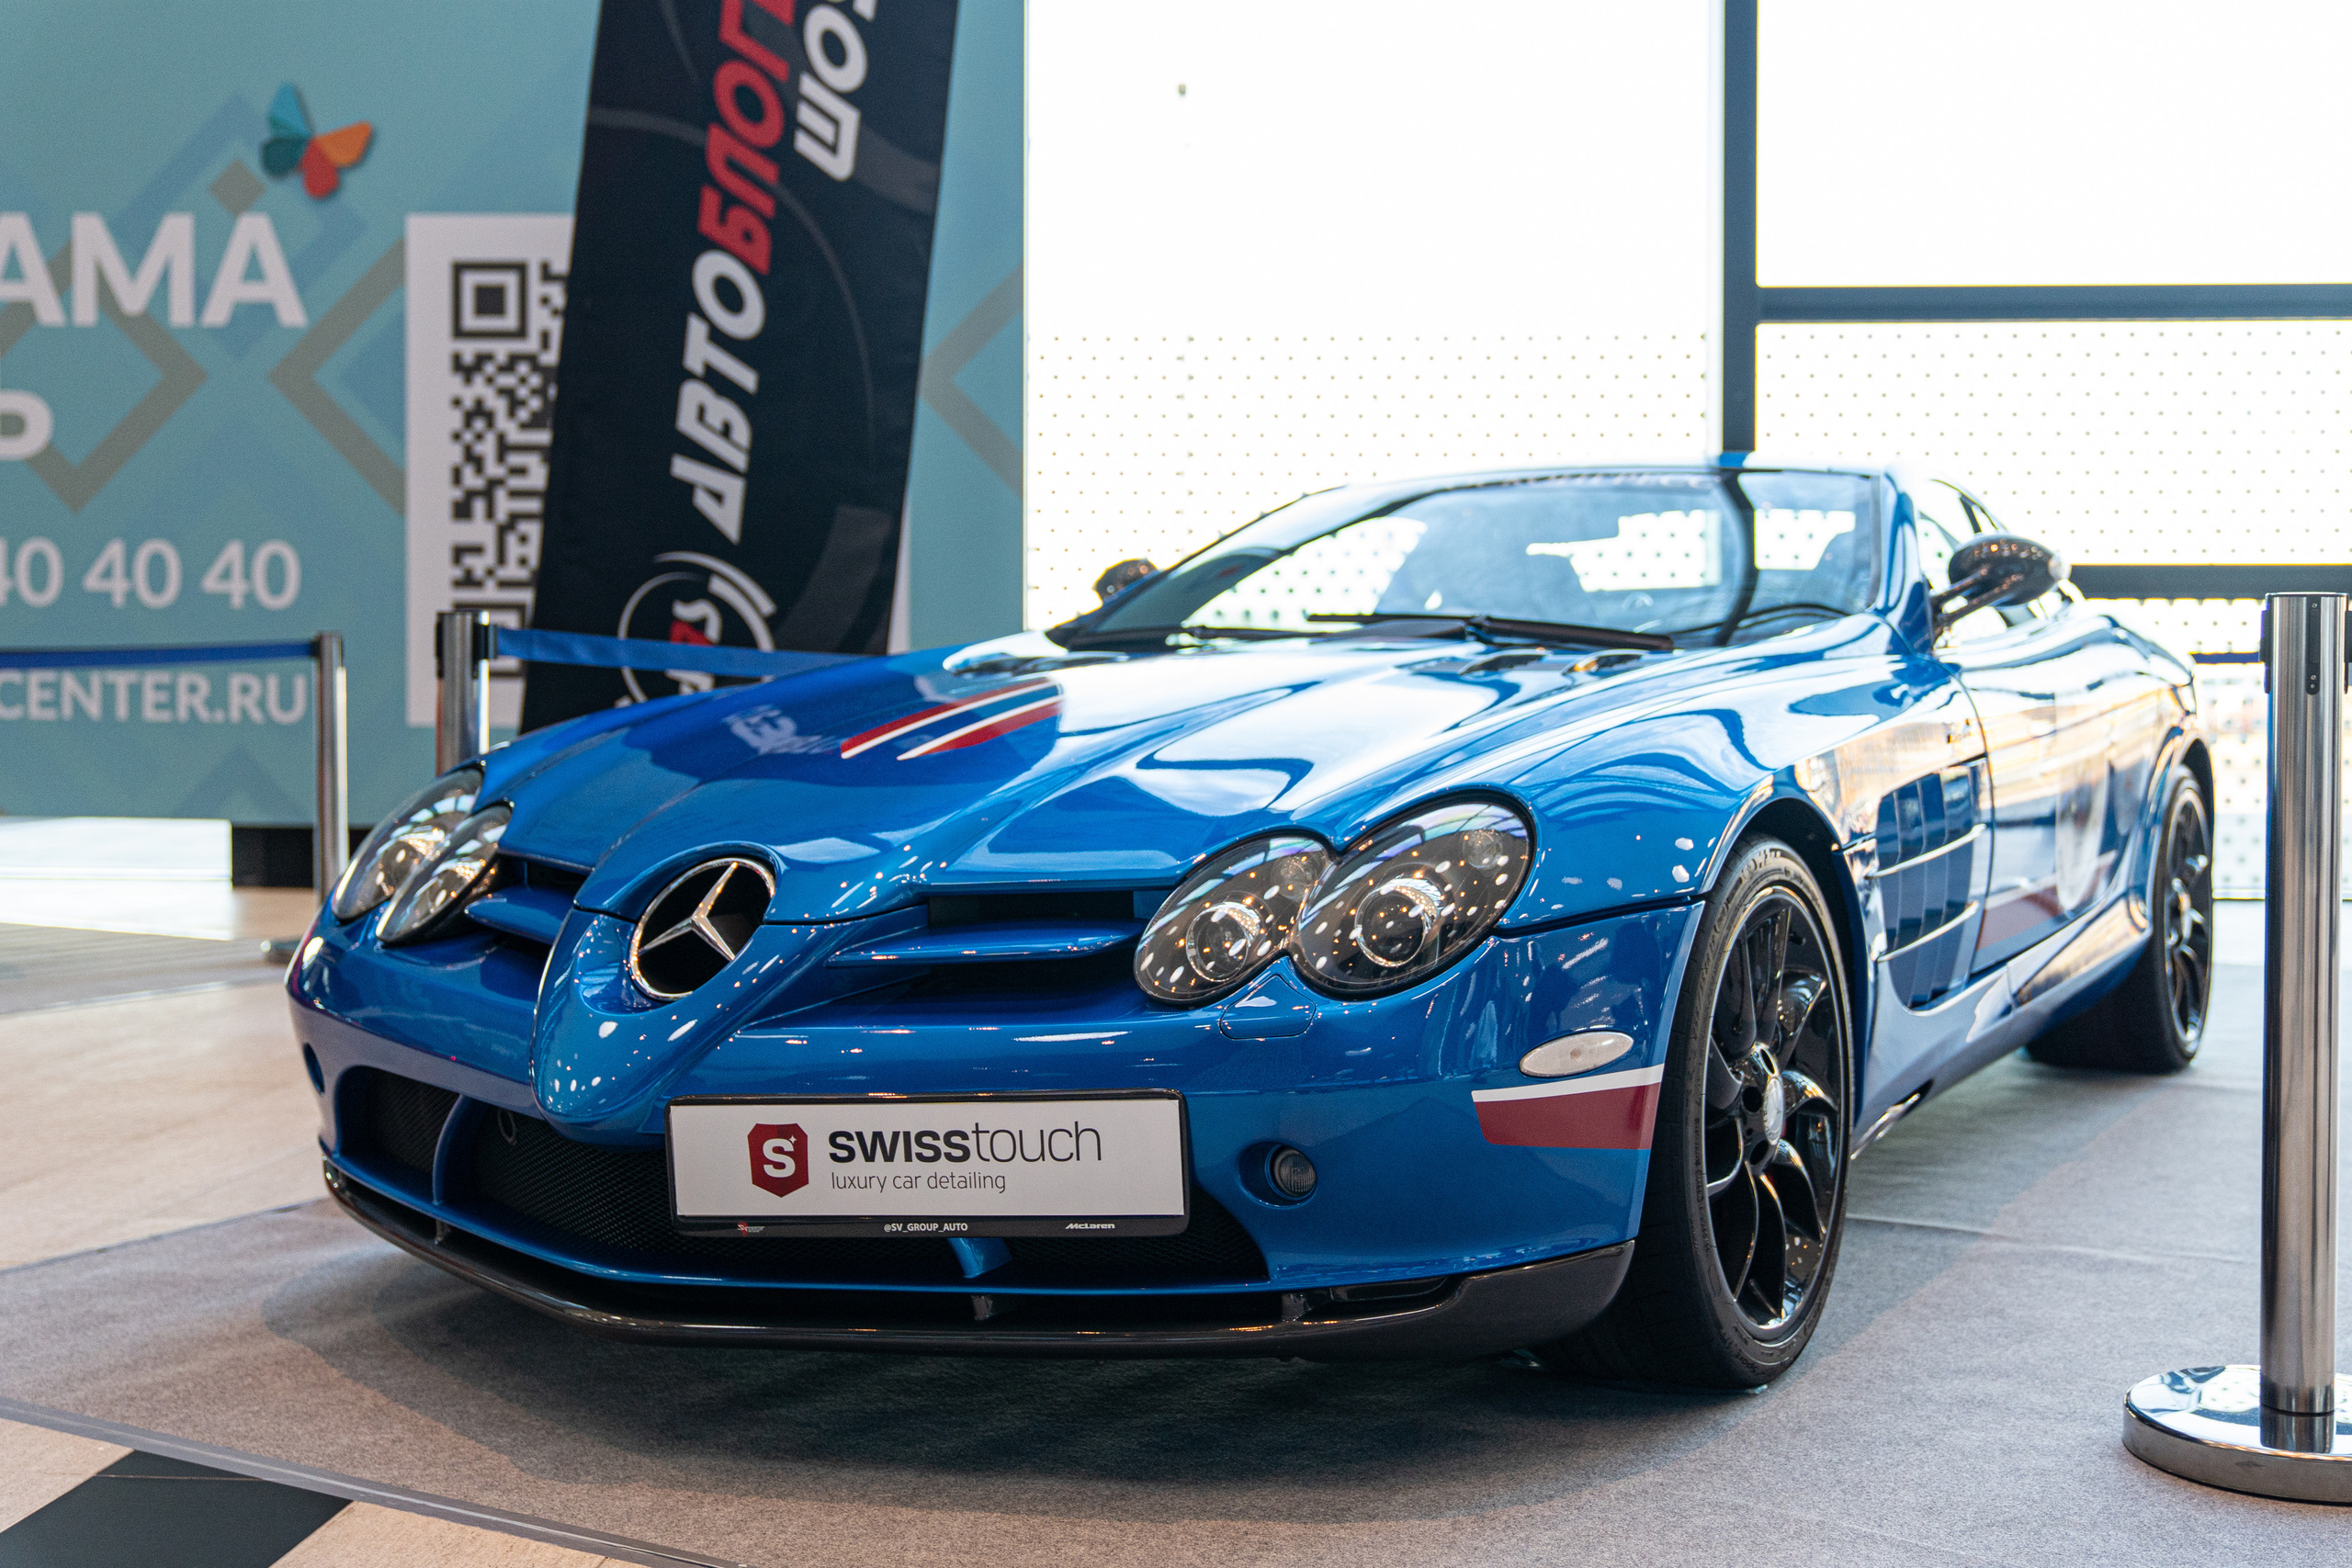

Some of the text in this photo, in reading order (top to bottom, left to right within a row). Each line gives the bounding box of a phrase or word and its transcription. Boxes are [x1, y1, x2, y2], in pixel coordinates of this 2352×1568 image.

[793, 0, 877, 182] ШО
[671, 0, 796, 546] АВТОБЛОГ
[82, 538, 183, 608] 40
[200, 539, 302, 610] 40
[0, 669, 308, 725] CENTER.RU
[763, 1138, 797, 1178] S
[831, 1171, 1006, 1194] luxury car detailing
[883, 1223, 968, 1233] @SV_GROUP_AUTO
